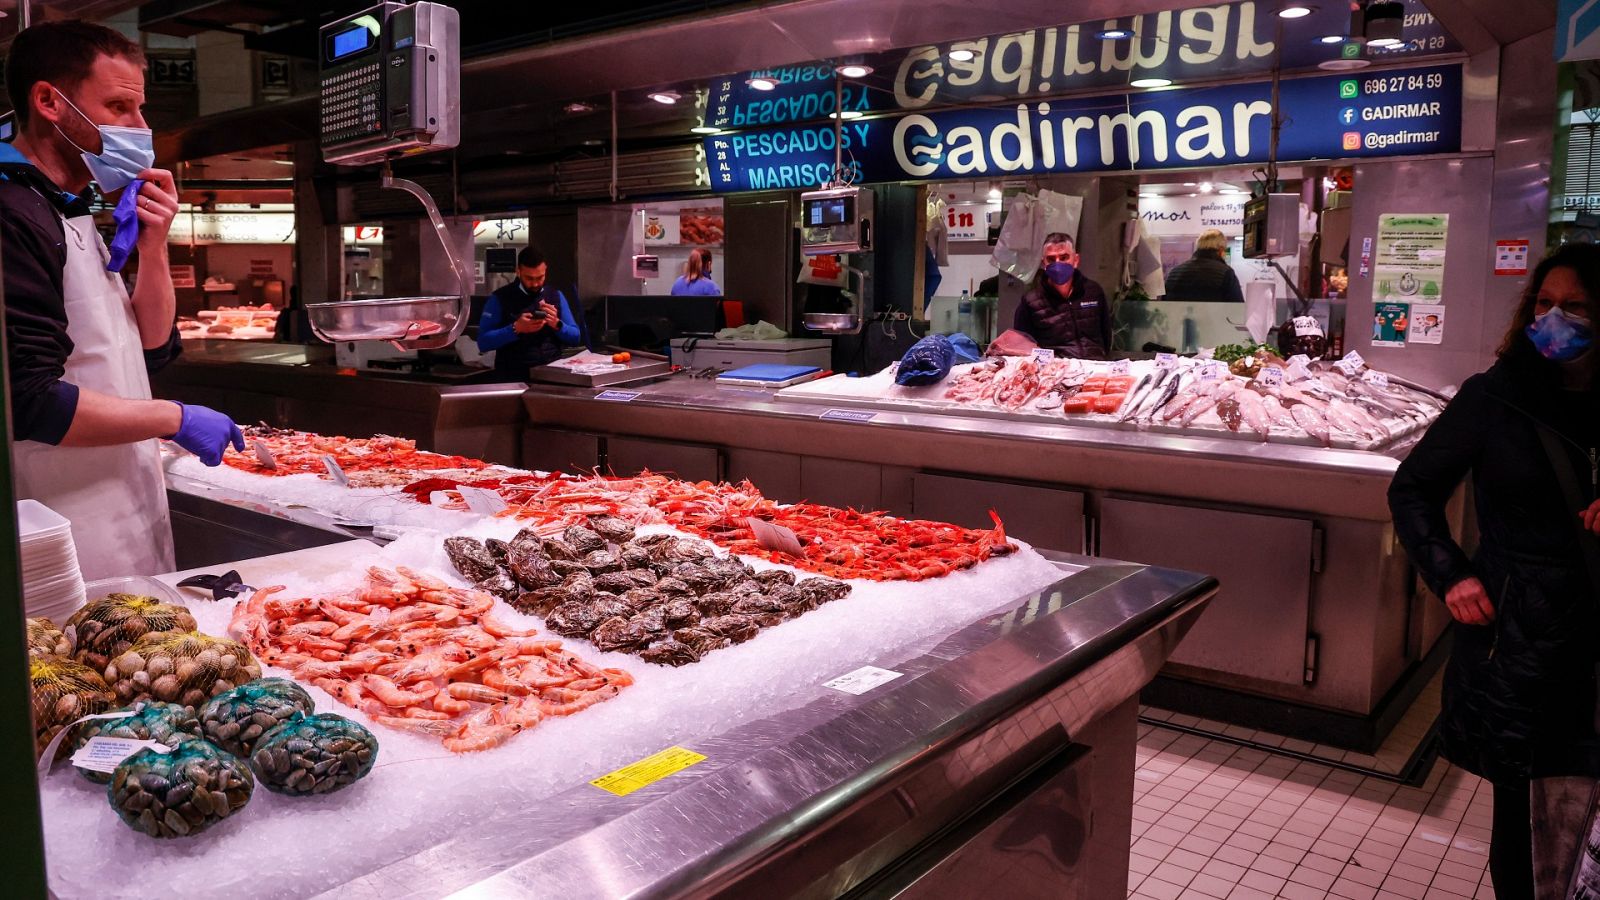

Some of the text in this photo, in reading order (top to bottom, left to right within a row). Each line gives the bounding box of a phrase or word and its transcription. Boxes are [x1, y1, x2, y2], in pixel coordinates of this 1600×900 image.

[1364, 73, 1442, 94] 696 27 84 59
[1362, 102, 1441, 121] GADIRMAR
[733, 124, 870, 158] PESCADOS Y
[893, 100, 1273, 176] Gadirmar
[1364, 130, 1440, 149] @gadirmar
[717, 152, 727, 160] 28
[720, 162, 731, 171] AL
[722, 173, 732, 182] 32
[193, 215, 258, 223] PESCADOS
[197, 233, 258, 241] MARISCOS
